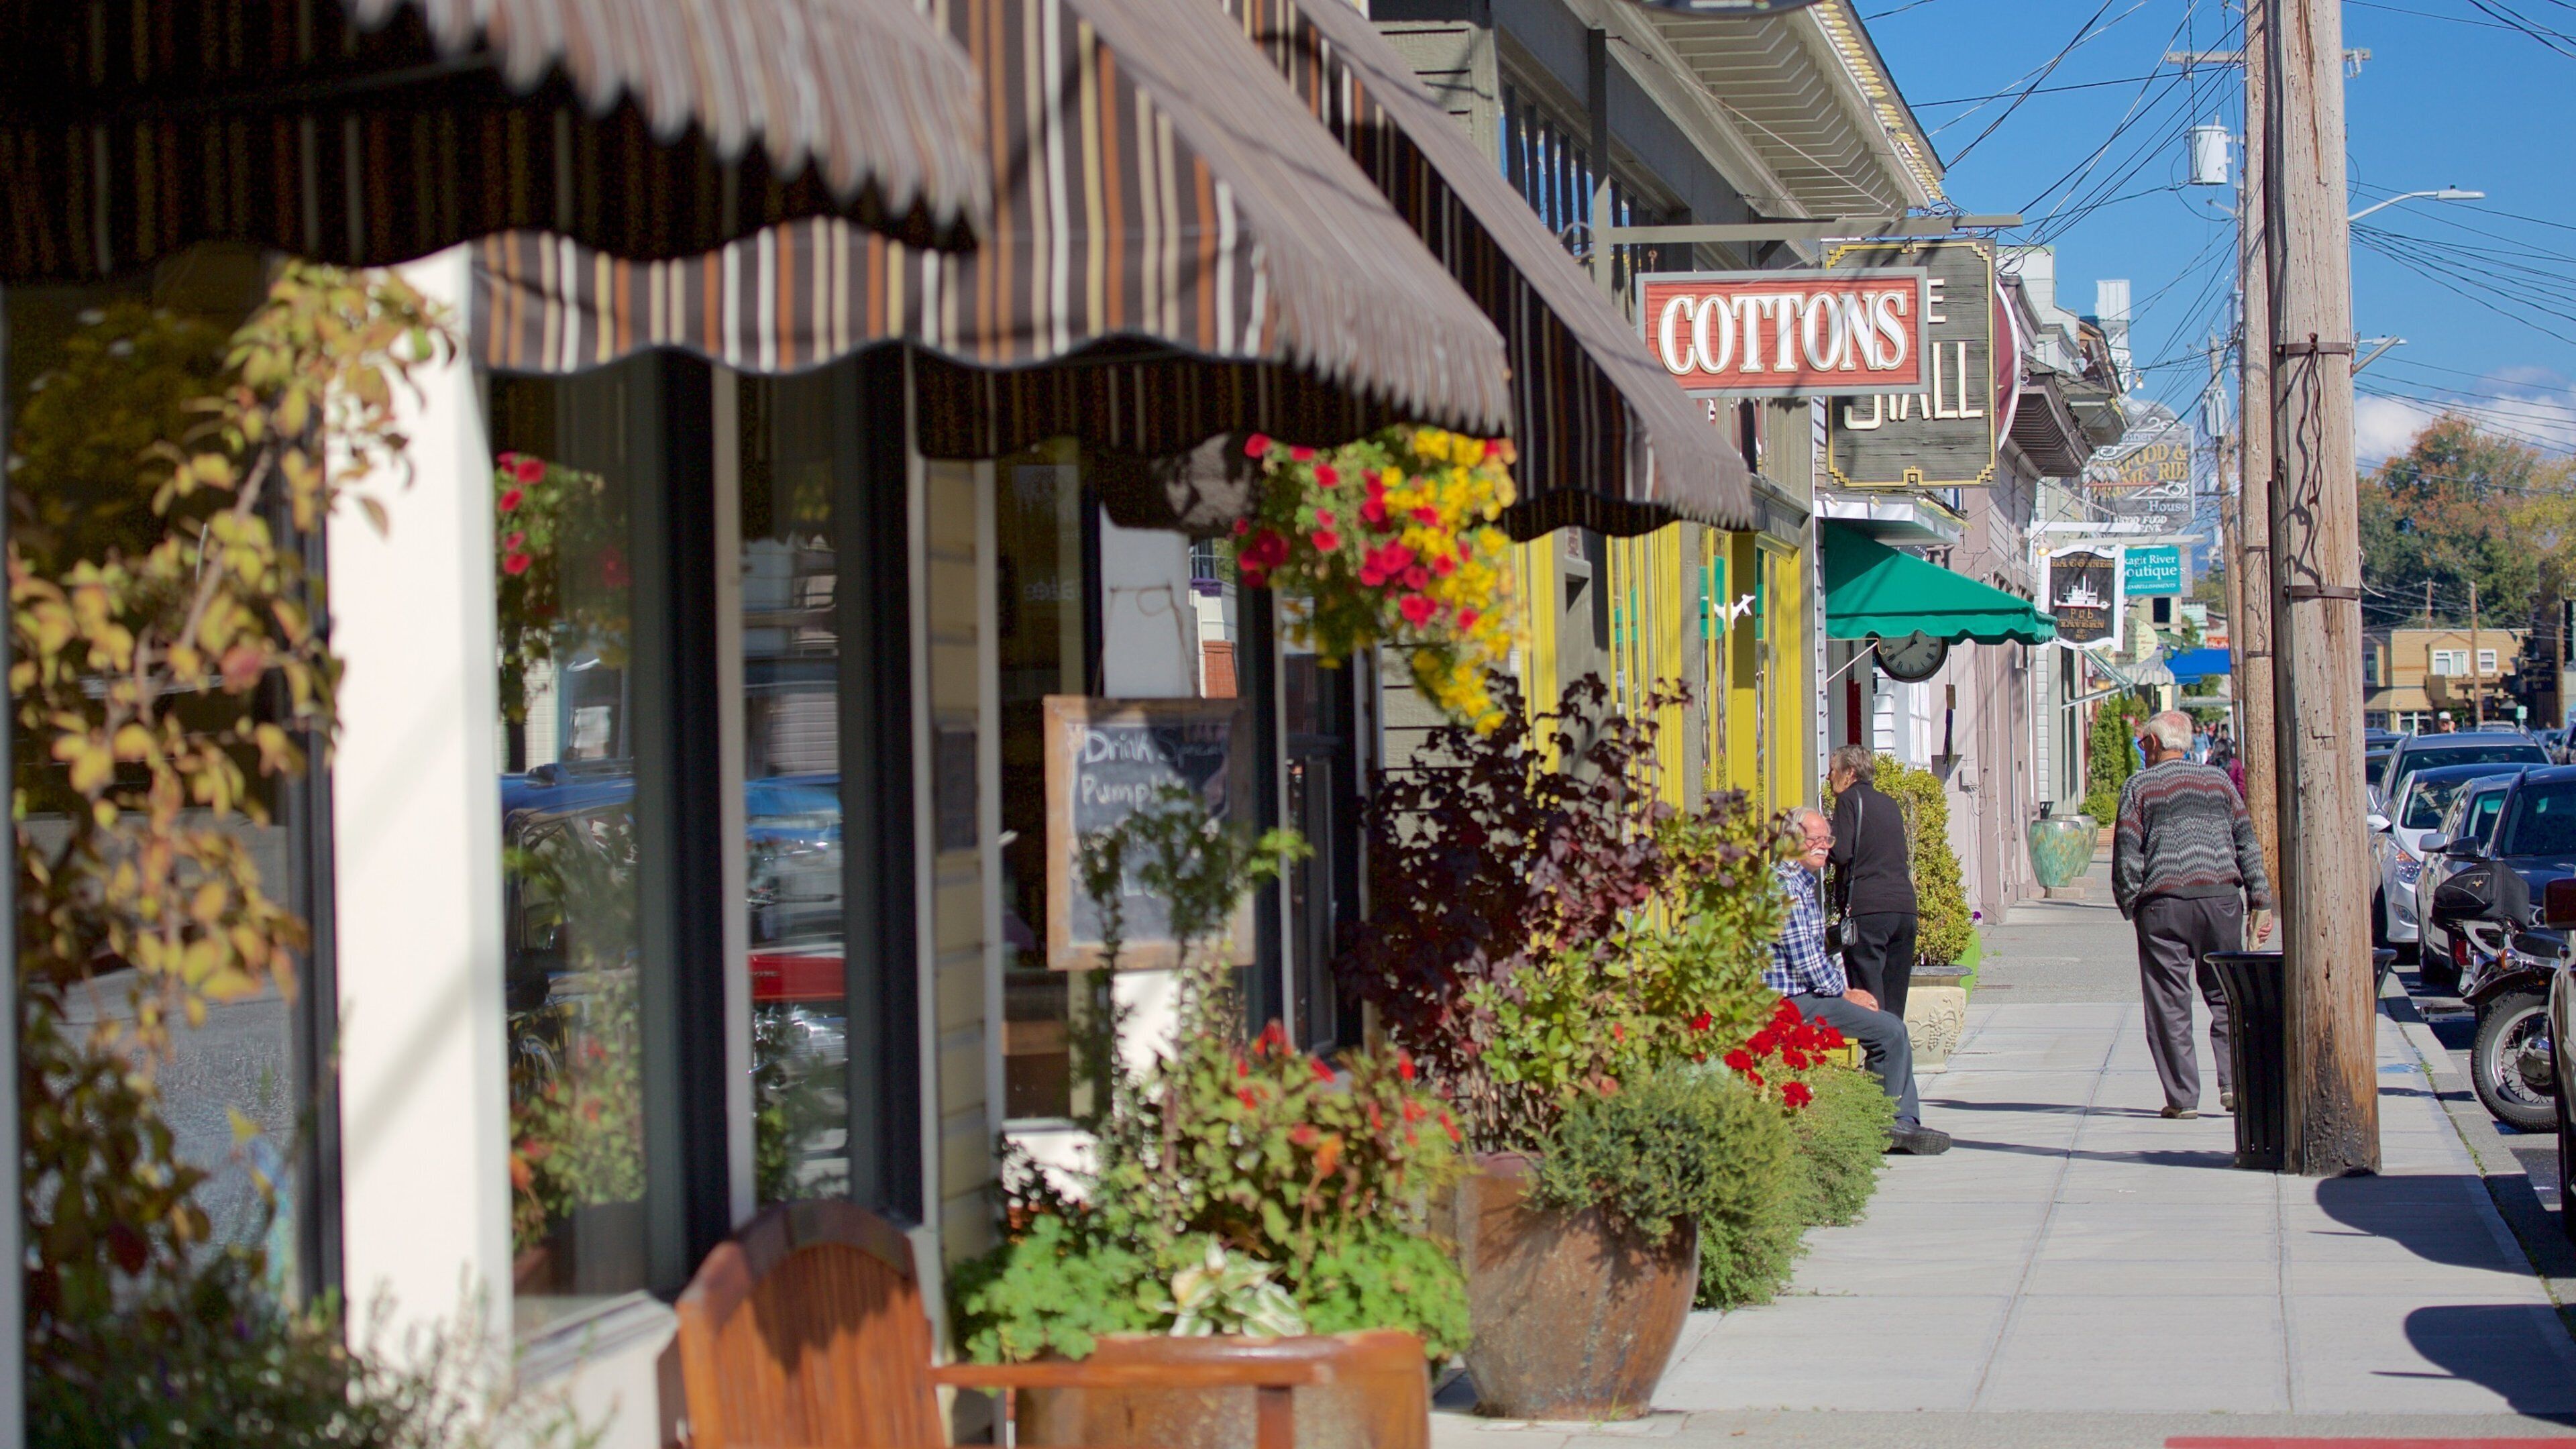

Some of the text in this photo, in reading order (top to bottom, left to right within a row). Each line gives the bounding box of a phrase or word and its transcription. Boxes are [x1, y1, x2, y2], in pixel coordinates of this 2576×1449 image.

[1658, 291, 1909, 376] COTTONS
[2157, 462, 2189, 481] RIB
[2148, 500, 2189, 513] House
[2143, 515, 2167, 524] FOOD
[2140, 524, 2163, 533] INK
[2069, 558, 2114, 568] CONNER
[2149, 554, 2176, 564] River
[2125, 565, 2178, 580] outique
[2070, 608, 2093, 619] Pub
[2059, 619, 2104, 629] TAVERN
[1084, 730, 1155, 764] Drink
